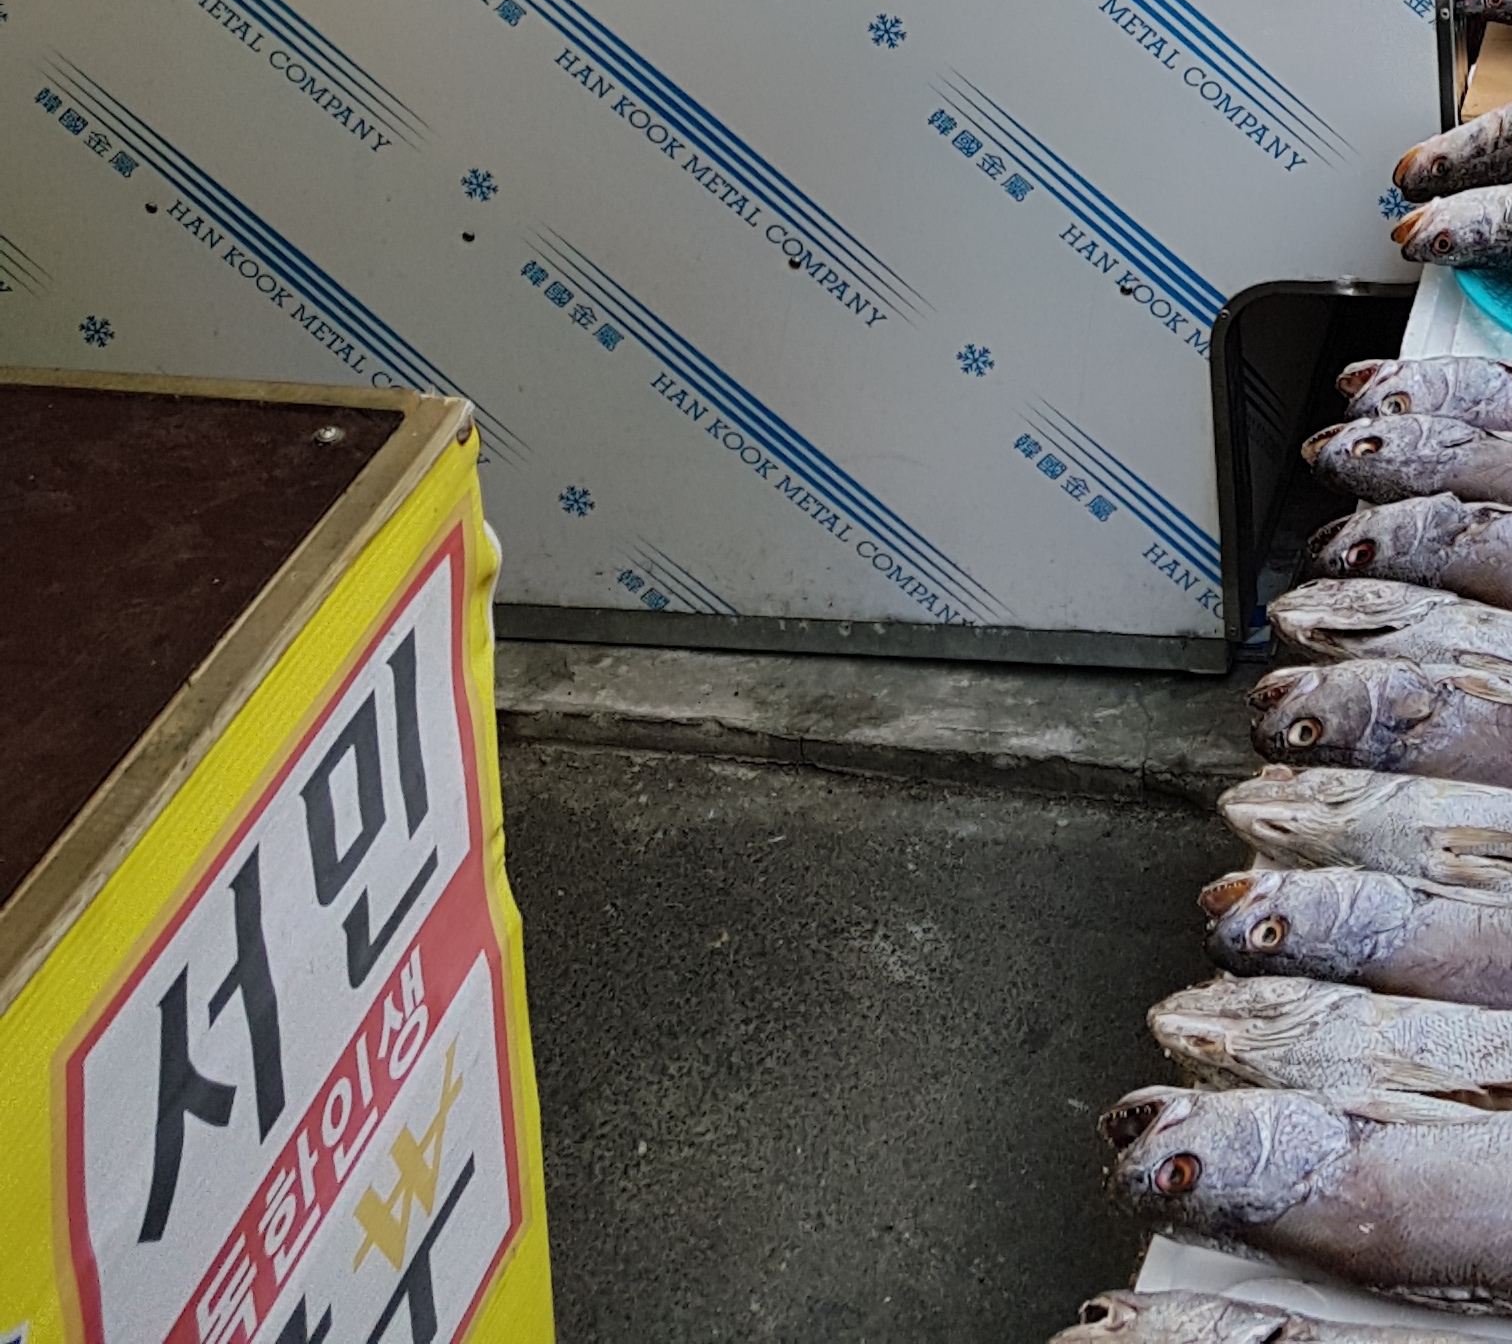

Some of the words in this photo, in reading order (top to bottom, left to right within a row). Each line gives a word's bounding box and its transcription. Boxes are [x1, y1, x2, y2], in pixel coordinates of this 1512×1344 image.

[269, 50, 390, 151] COMPANY
[1183, 66, 1305, 170] COMPANY
[554, 47, 614, 98] HAN
[611, 95, 684, 158] KOOK
[681, 154, 760, 226] METAL
[765, 224, 885, 325] COMPANY
[166, 199, 223, 248] HAN
[221, 245, 292, 307] KOOK
[290, 304, 365, 373] METAL
[1059, 223, 1119, 273] HAN
[1115, 270, 1188, 333] KOOK
[650, 372, 708, 420] HAN
[705, 418, 777, 479] KOOK
[774, 474, 851, 542] METAL
[1142, 542, 1200, 590] HAN
[138, 626, 438, 1243] 서민
